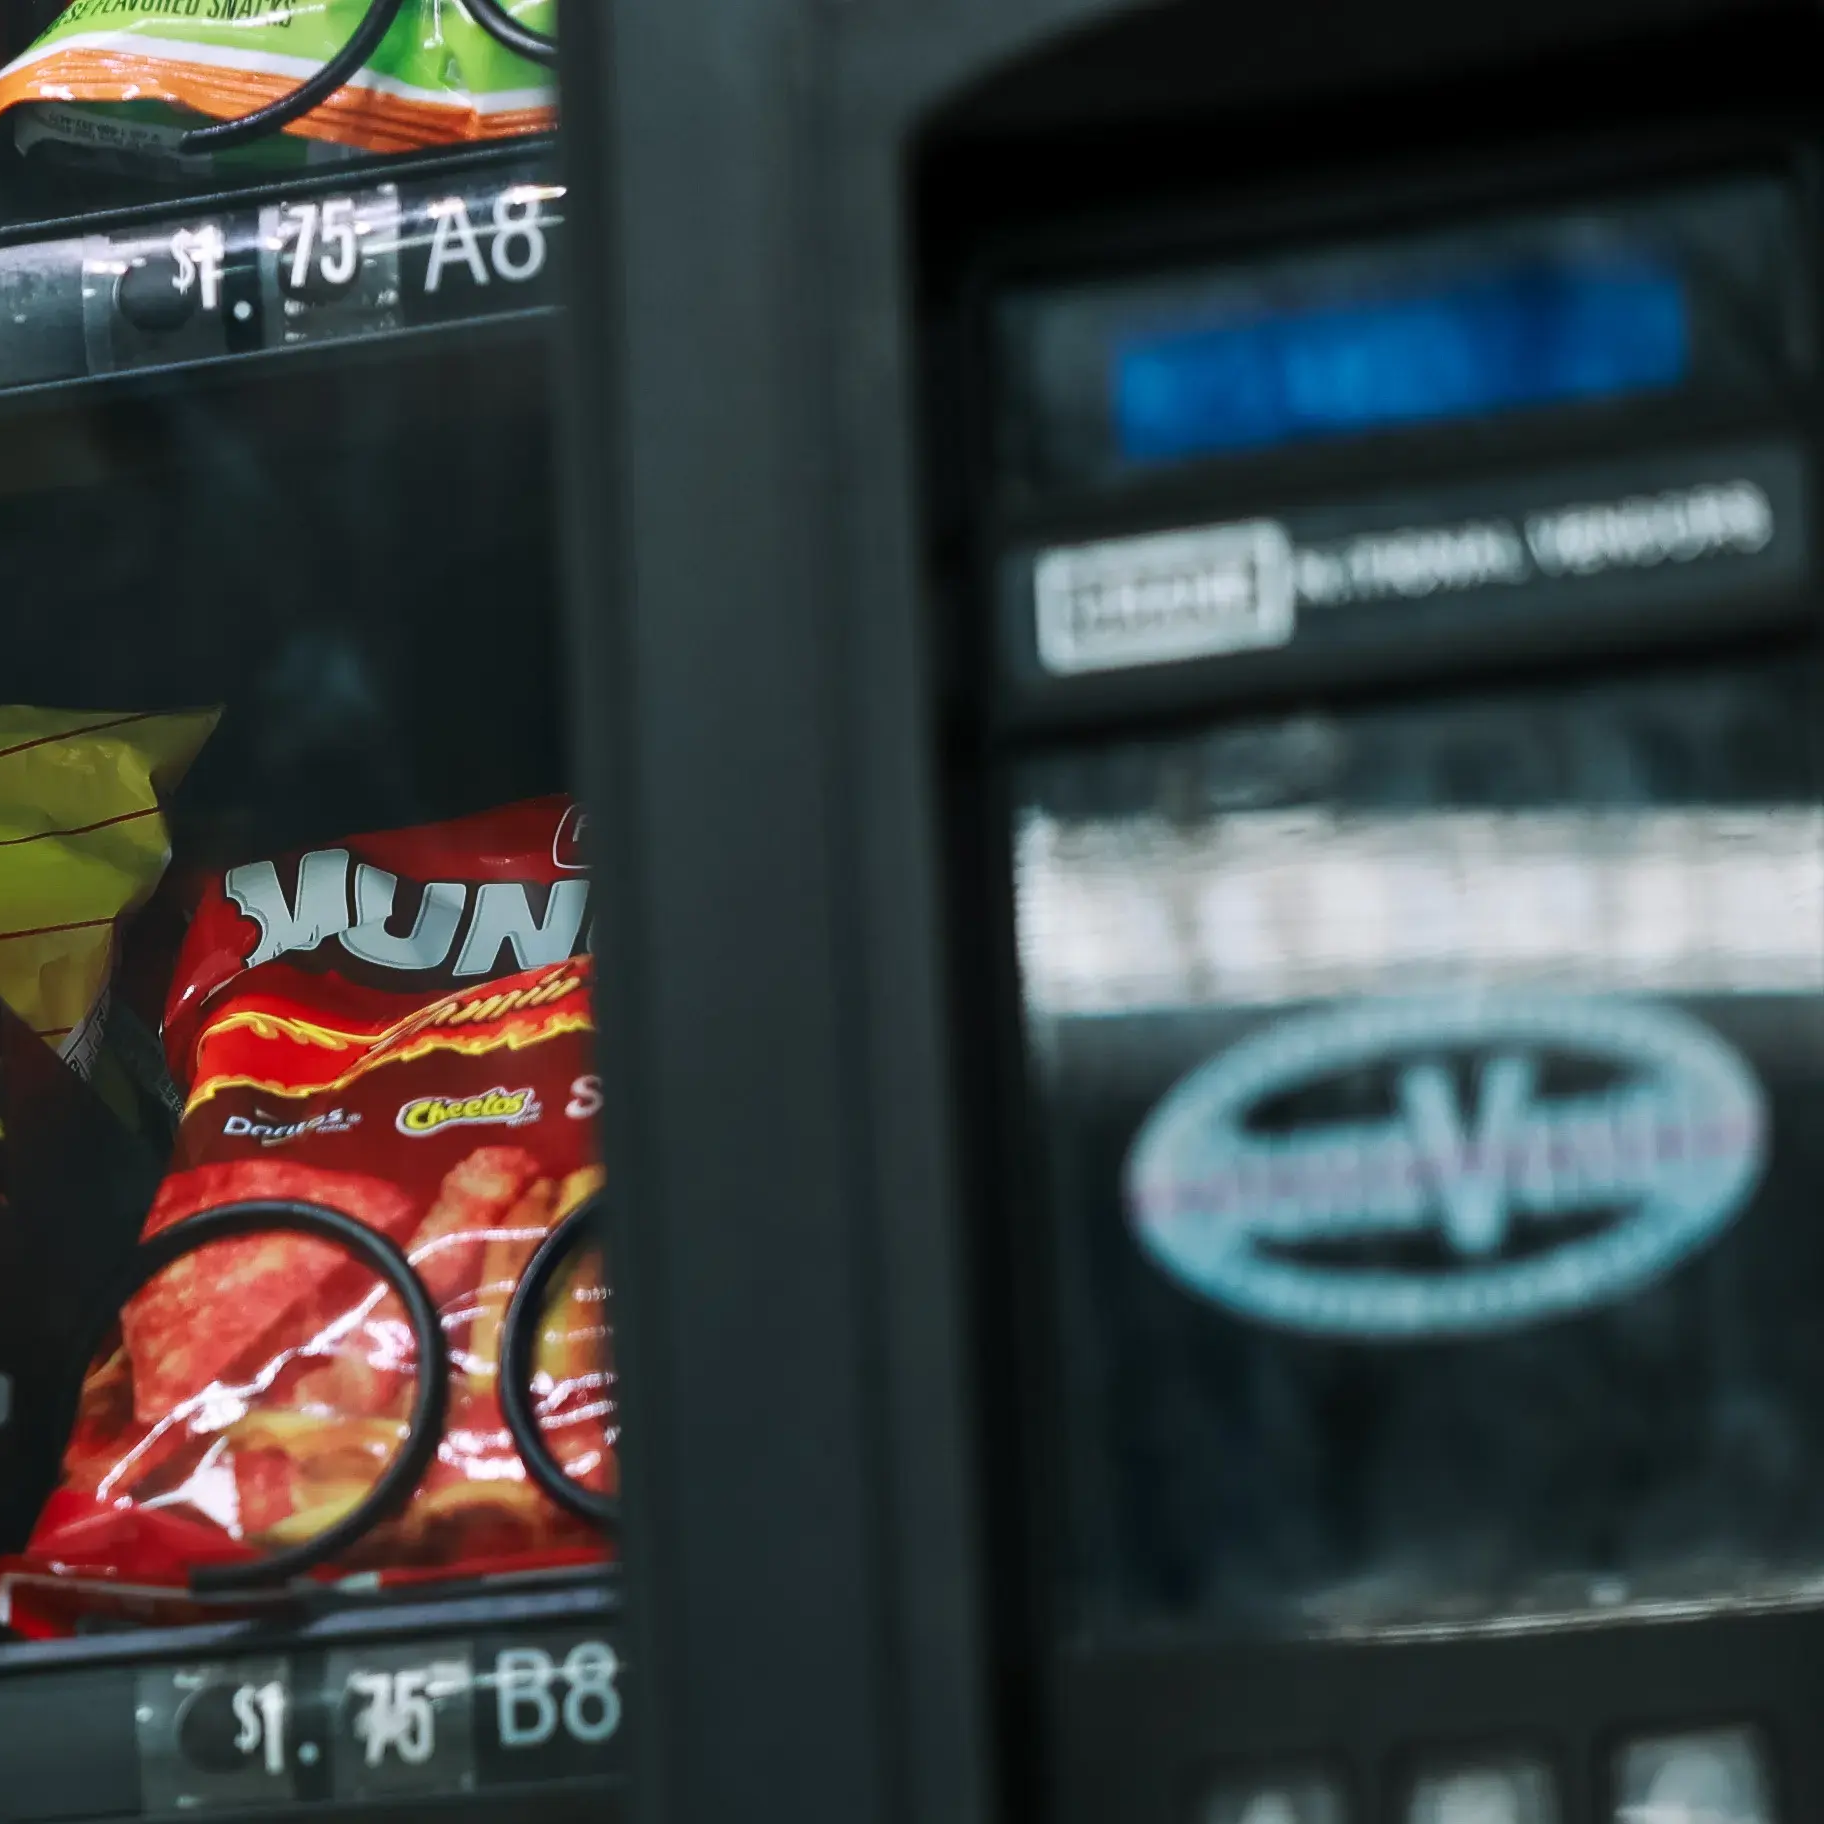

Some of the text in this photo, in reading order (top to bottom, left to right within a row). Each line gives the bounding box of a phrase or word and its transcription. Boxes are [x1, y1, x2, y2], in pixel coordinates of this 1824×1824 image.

[424, 191, 544, 293] A8
[405, 1089, 529, 1130] Cheetos
[496, 1641, 621, 1749] B8
